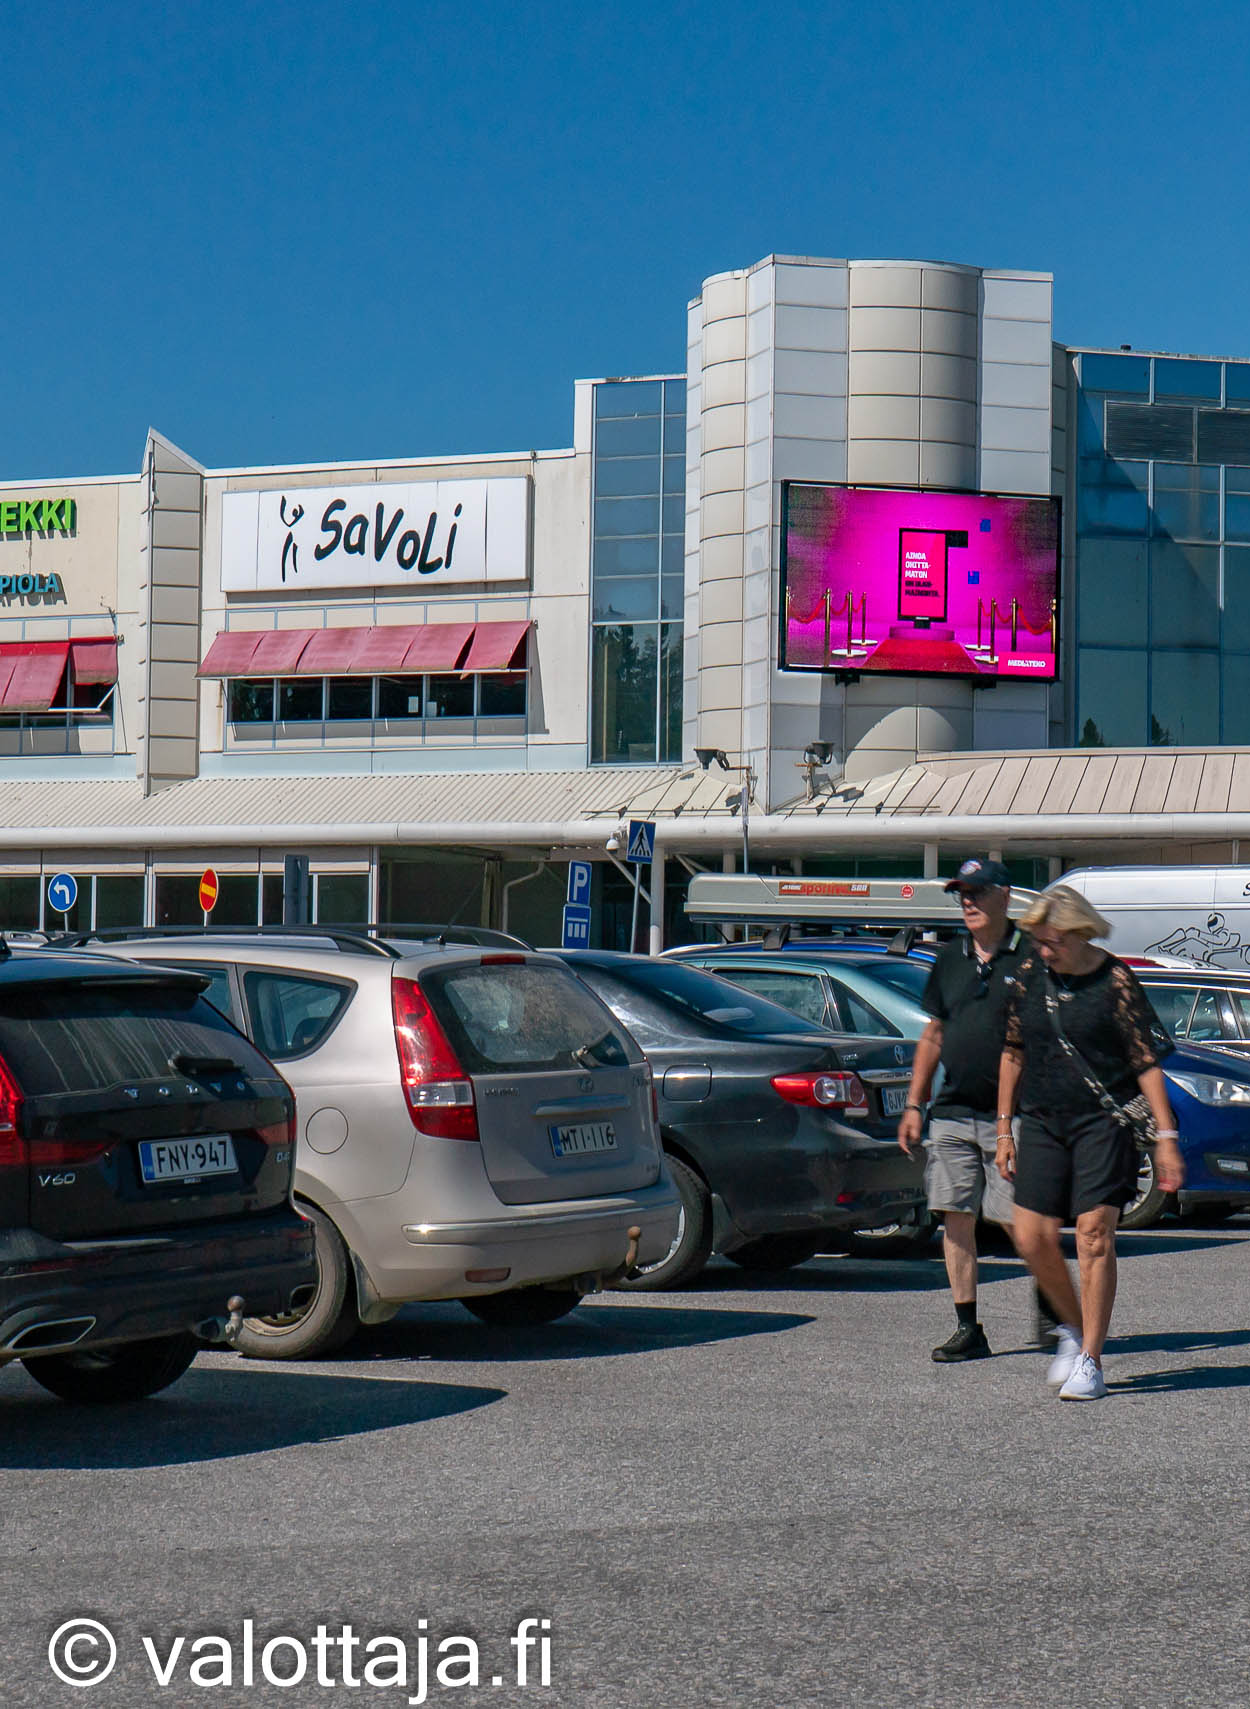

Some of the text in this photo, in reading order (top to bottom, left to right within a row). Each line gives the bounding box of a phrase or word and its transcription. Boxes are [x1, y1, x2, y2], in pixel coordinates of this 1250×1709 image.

[573, 865, 588, 901] P
[155, 1141, 228, 1174] FNY-947
[38, 1172, 77, 1188] V60
